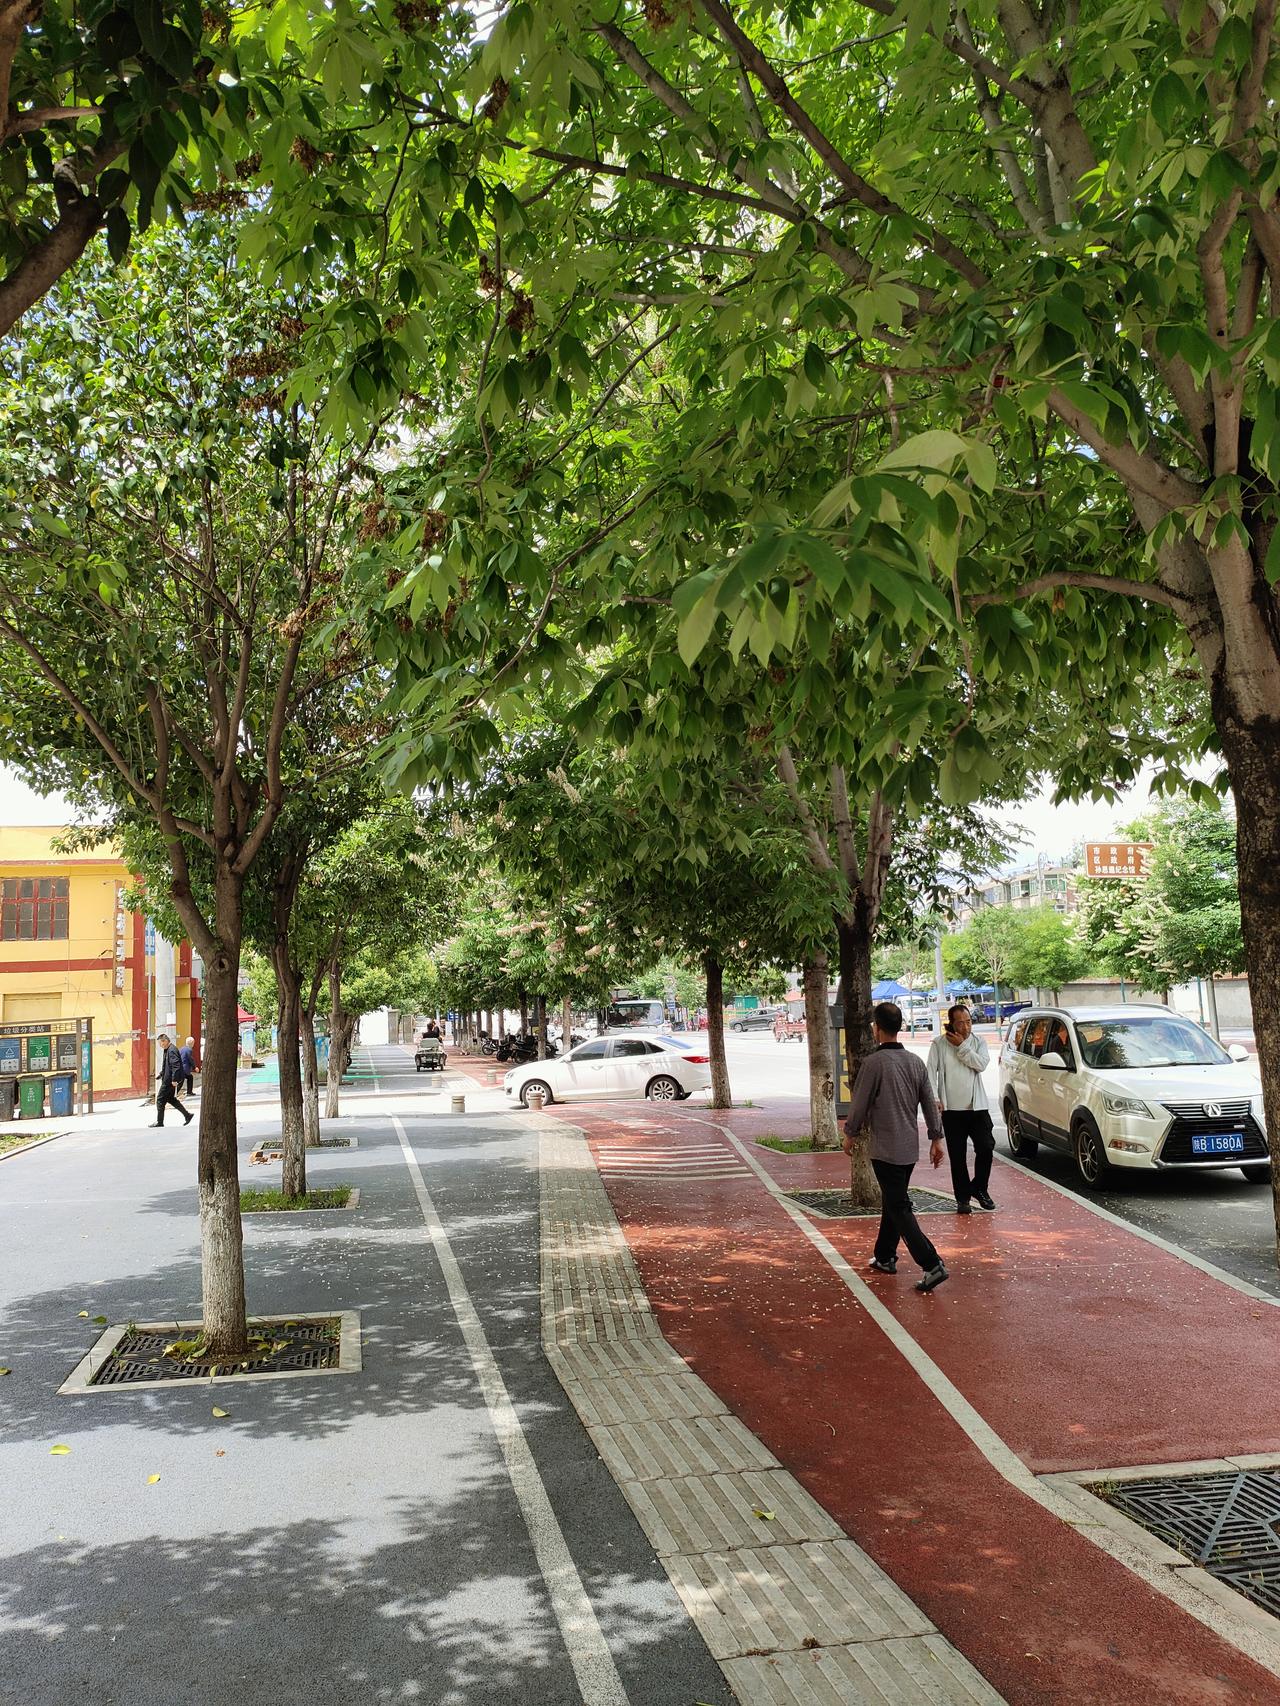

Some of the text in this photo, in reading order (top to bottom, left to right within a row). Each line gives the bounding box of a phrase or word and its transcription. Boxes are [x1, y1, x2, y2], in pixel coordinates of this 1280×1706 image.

[3, 1025, 45, 1034] 垃圾分类站
